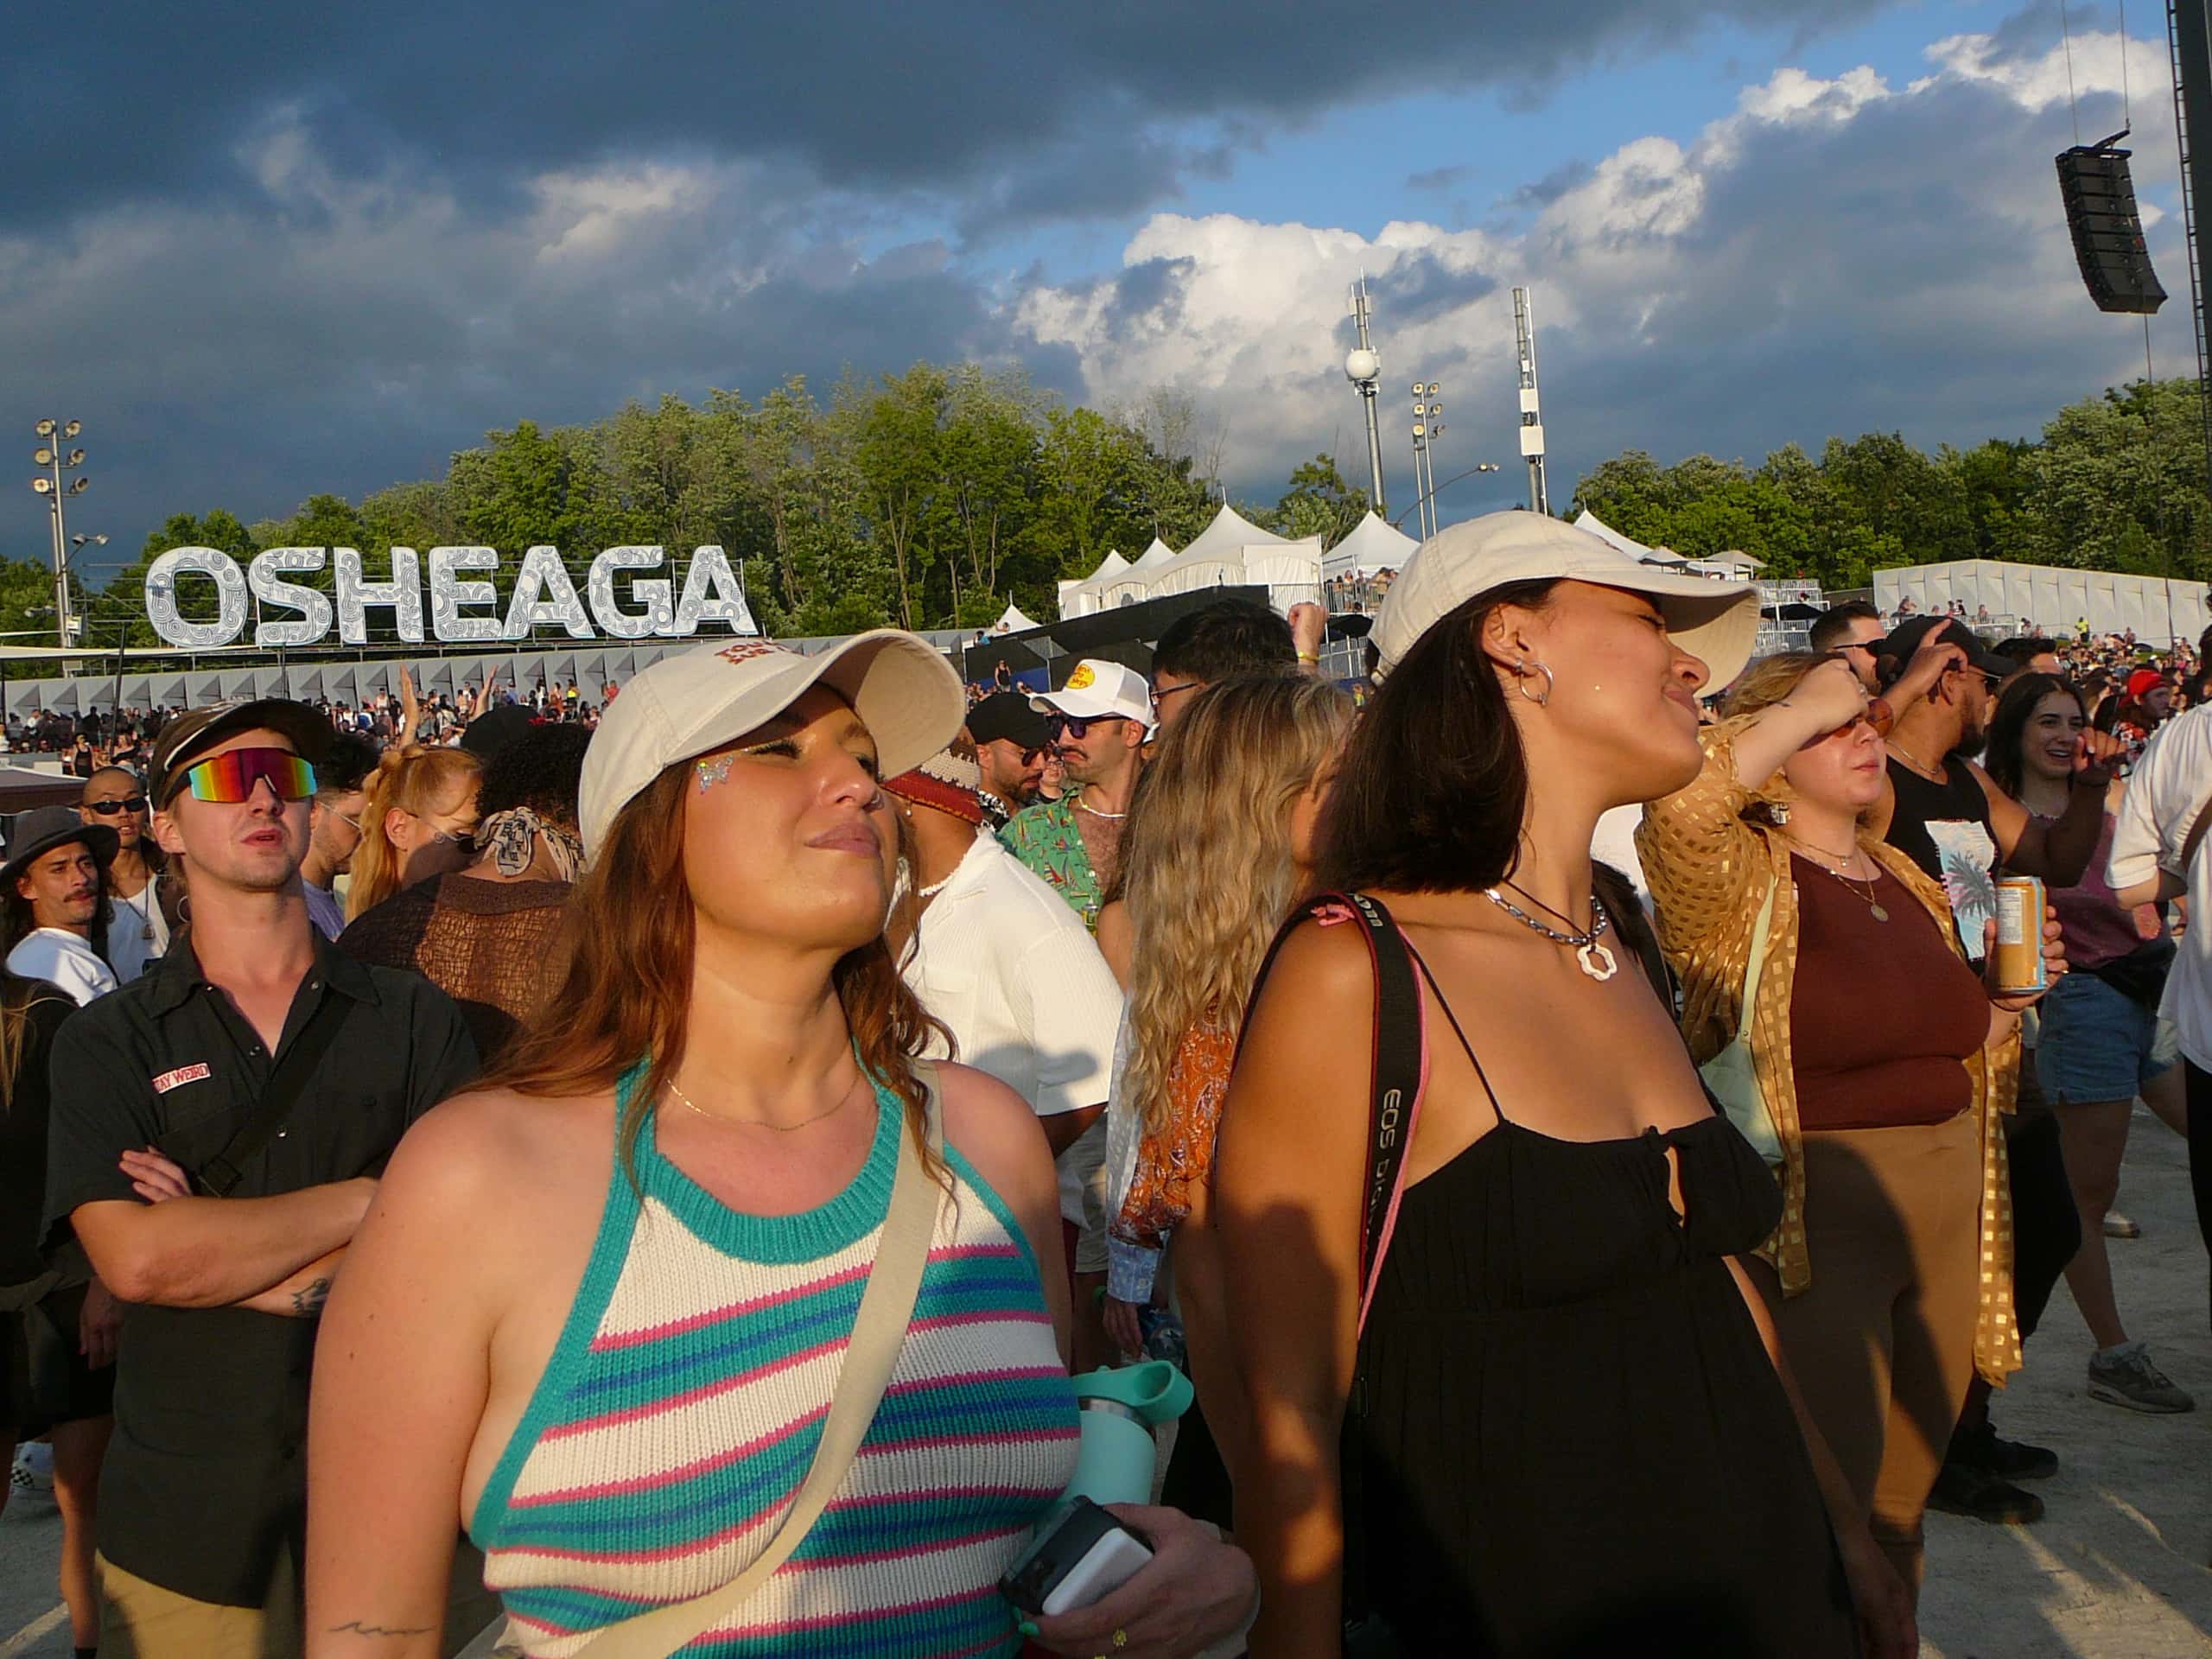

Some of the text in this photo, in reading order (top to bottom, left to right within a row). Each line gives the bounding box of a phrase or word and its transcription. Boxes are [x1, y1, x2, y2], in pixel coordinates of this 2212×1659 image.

[145, 545, 759, 648] OSHEAGA
[153, 1065, 207, 1091] TAY WEIRD
[1380, 1089, 1402, 1148] EOS
